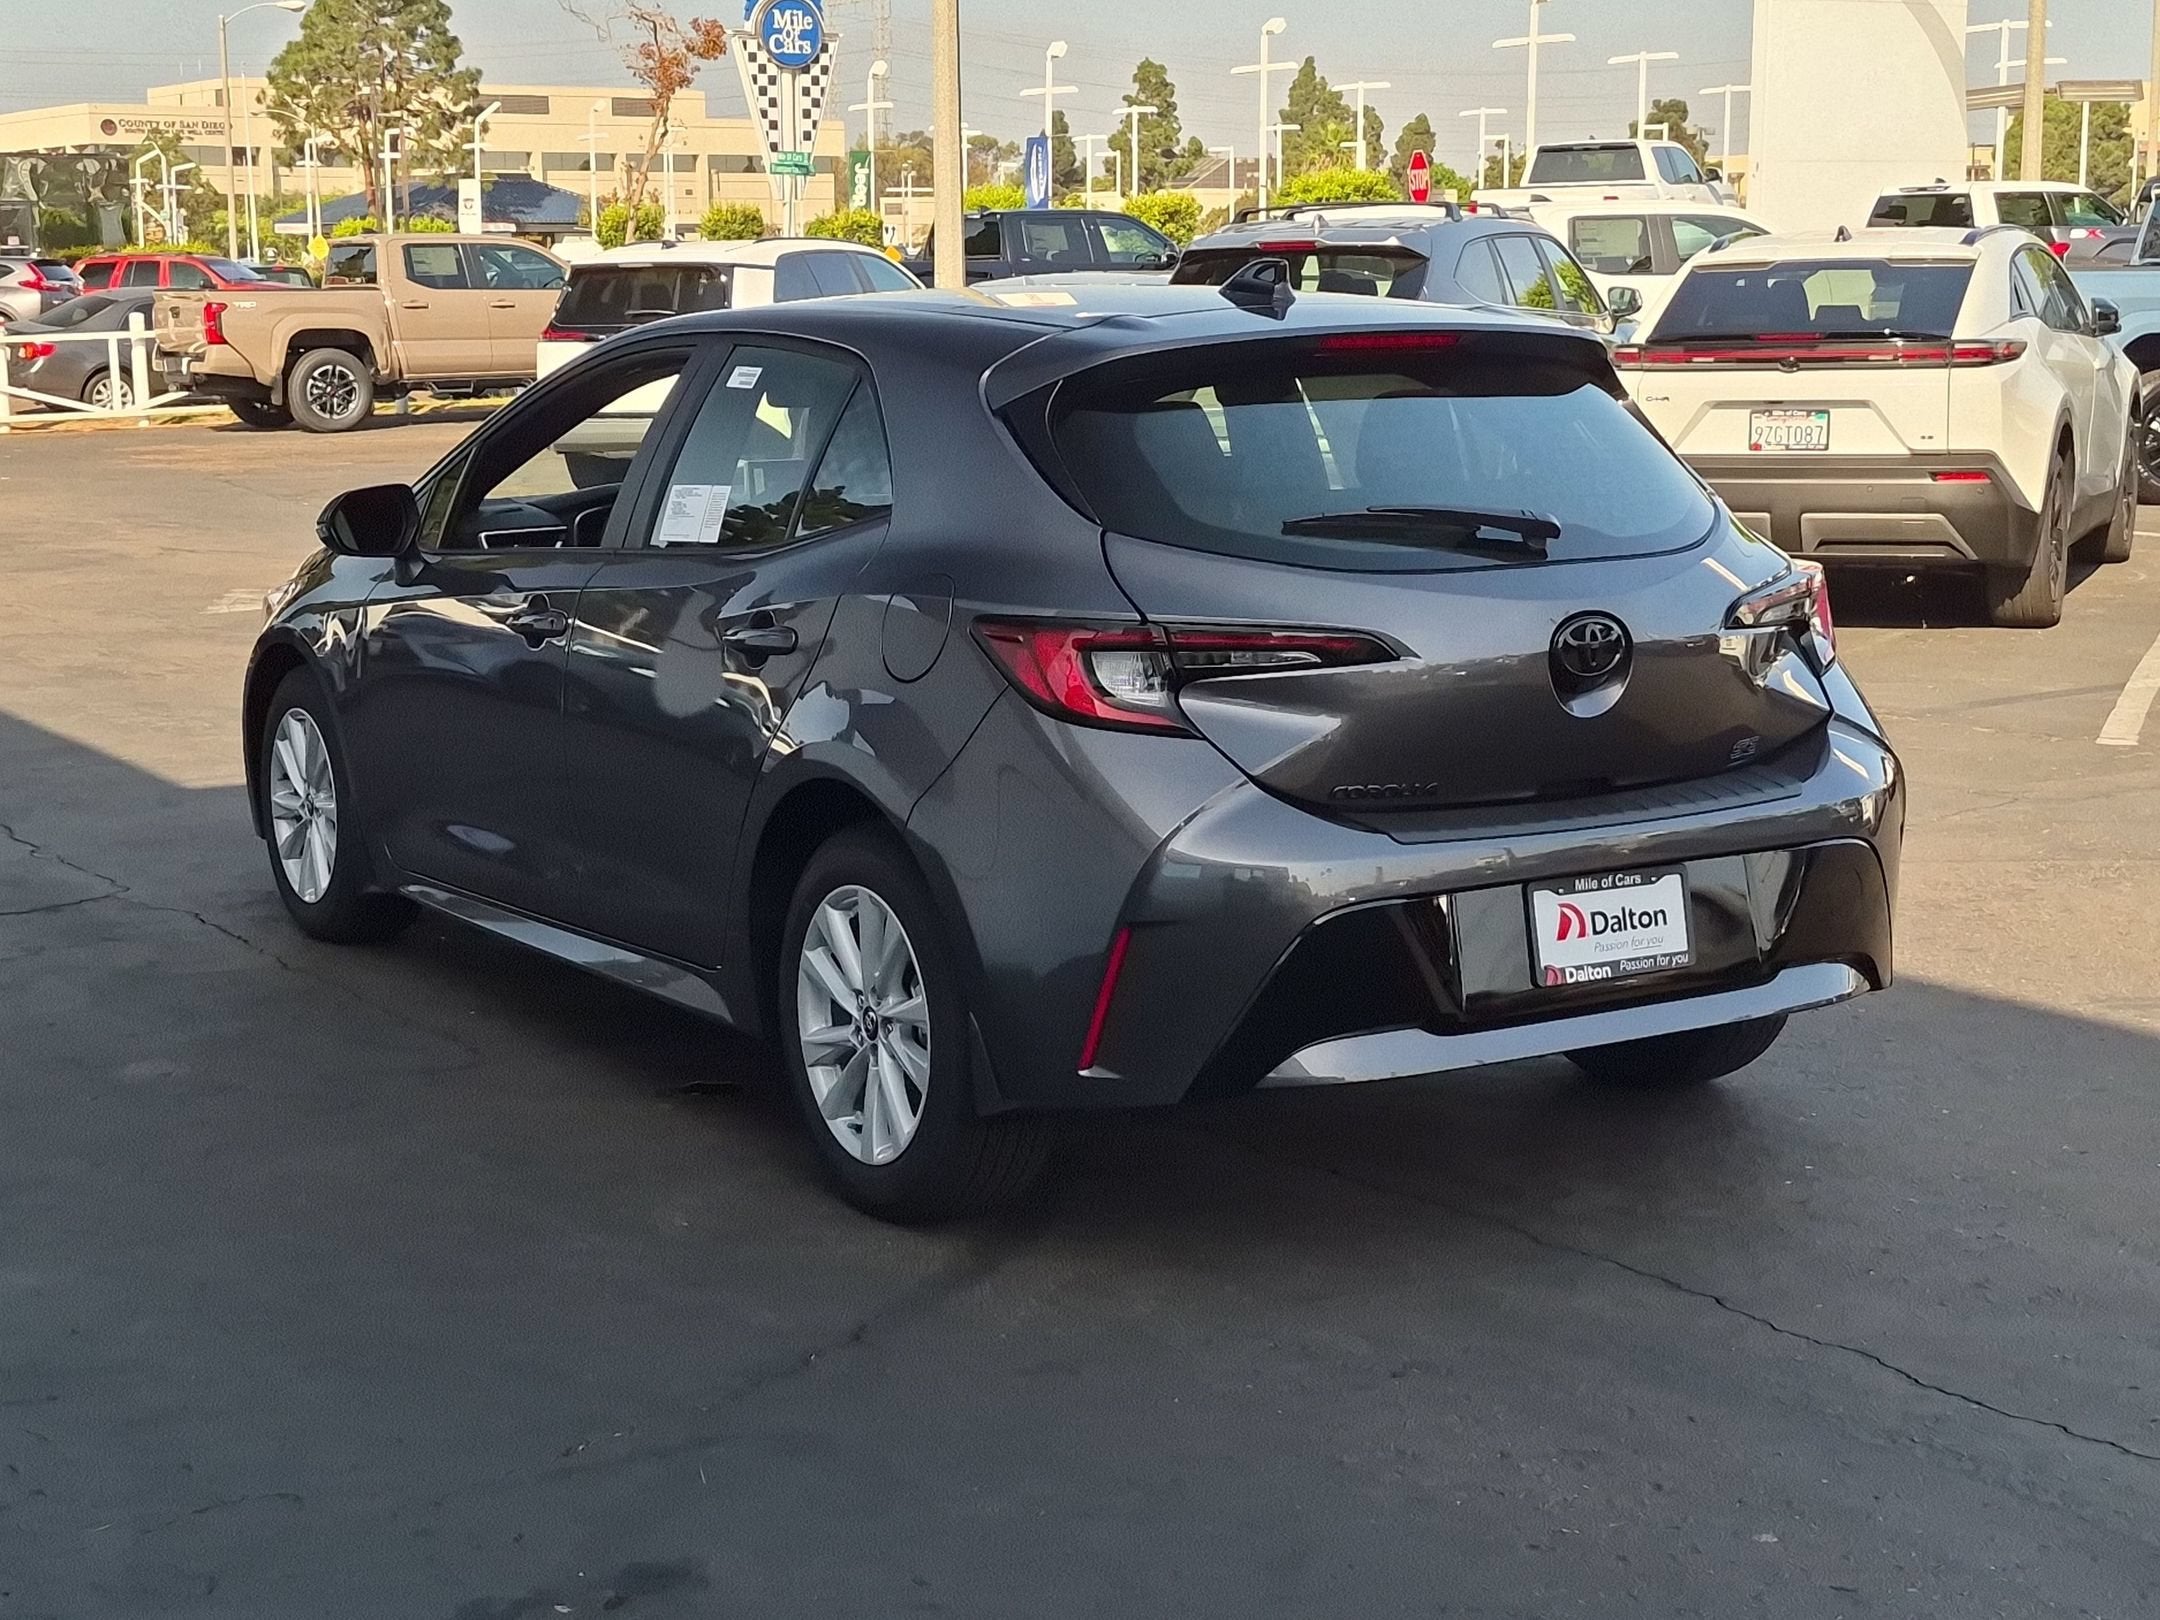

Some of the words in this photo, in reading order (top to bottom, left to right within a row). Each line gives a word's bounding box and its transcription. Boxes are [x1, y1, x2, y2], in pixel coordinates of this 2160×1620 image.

[772, 9, 813, 30] Mile
[769, 33, 812, 54] Cars
[782, 27, 800, 41] of
[118, 119, 160, 129] COUNTY
[163, 121, 177, 129] OF
[180, 121, 199, 129] SAN
[201, 121, 227, 130] DIEG
[1409, 169, 1430, 191] STOP
[1755, 425, 1824, 444] 9ZGT087
[1574, 878, 1598, 892] Mile
[1601, 875, 1613, 888] of
[1615, 873, 1642, 886] Cars
[1590, 906, 1668, 936] Dalton
[1594, 939, 1629, 953] Passion
[1631, 936, 1646, 949] for
[1647, 936, 1664, 949] you
[1564, 965, 1612, 984] Dalton
[1619, 957, 1655, 972] Passion
[1656, 955, 1669, 967] for
[1671, 953, 1689, 968] you
